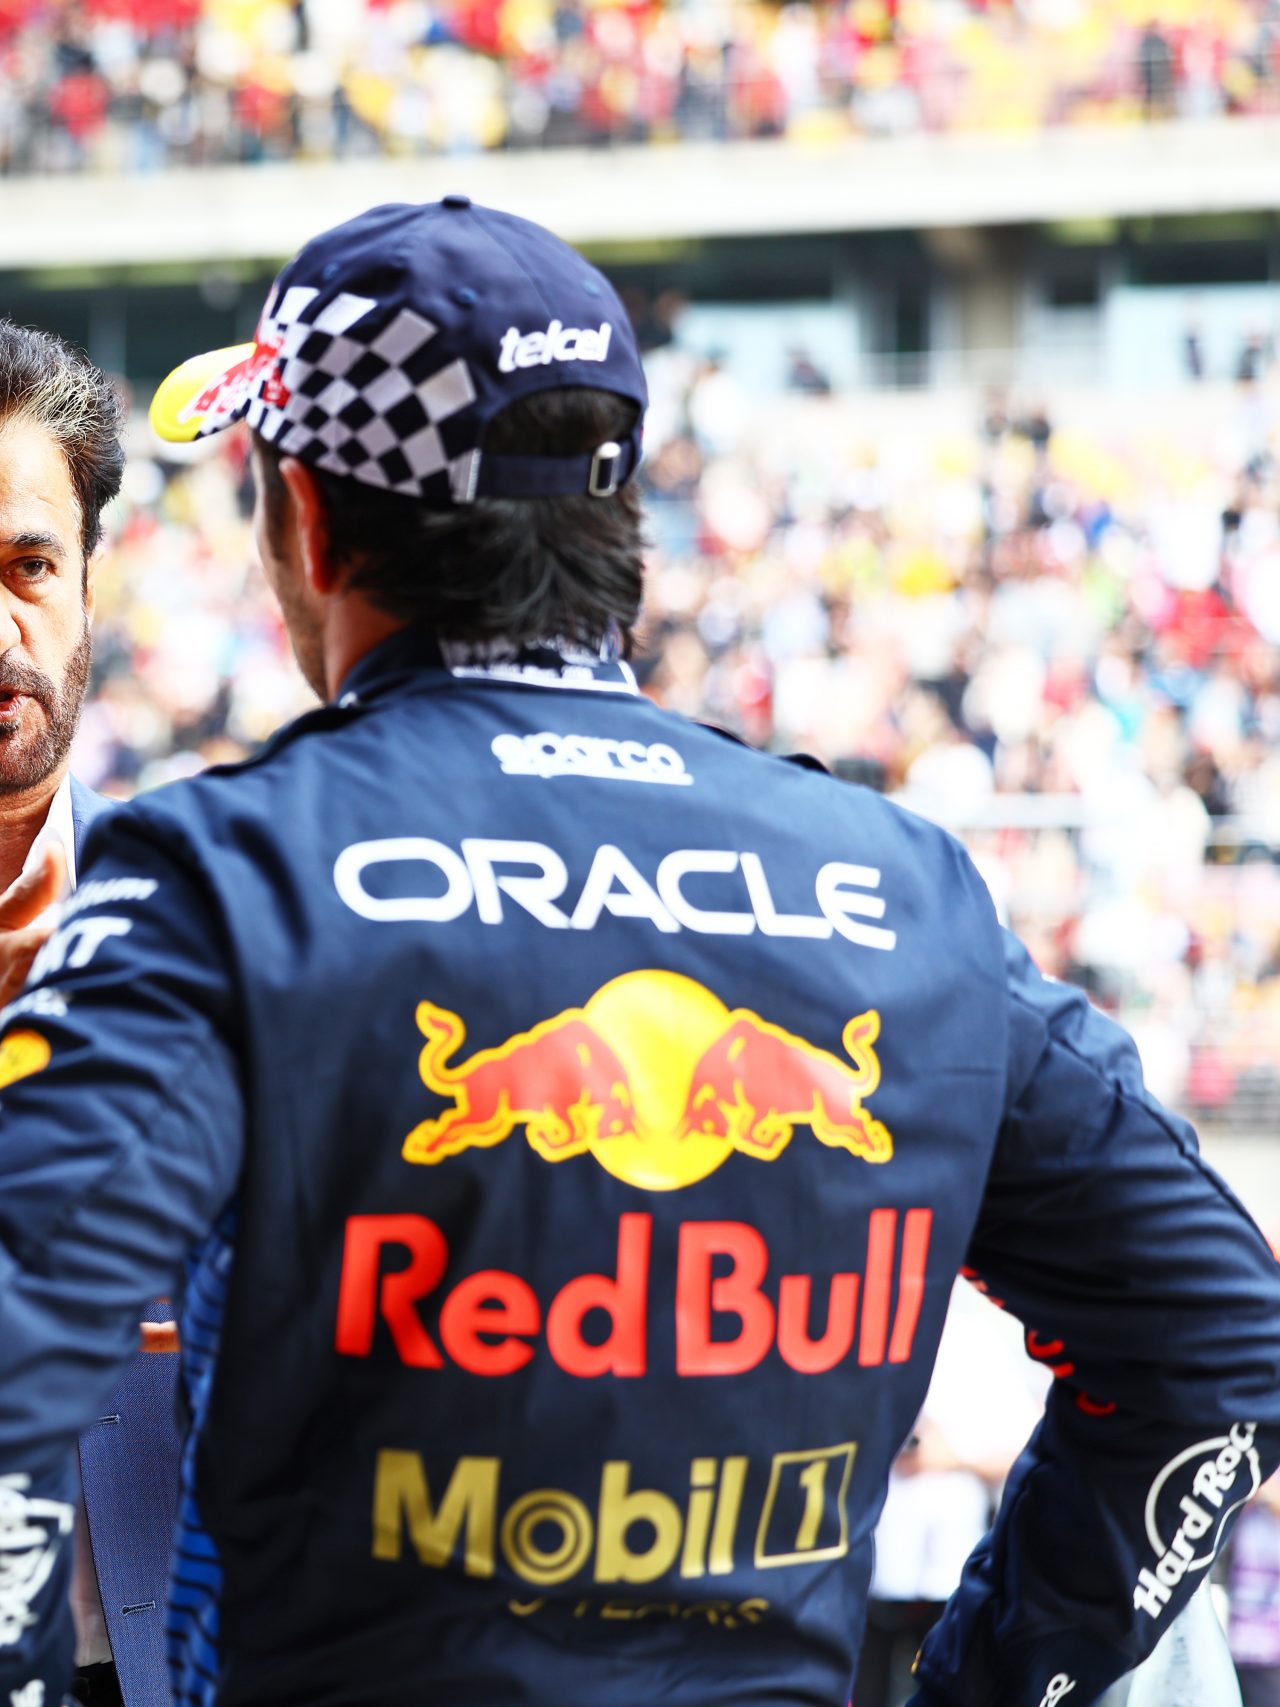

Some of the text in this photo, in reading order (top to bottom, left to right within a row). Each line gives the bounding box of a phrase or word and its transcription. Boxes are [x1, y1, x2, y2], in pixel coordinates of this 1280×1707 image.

[498, 319, 612, 373] telcel
[333, 836, 897, 951] ORACLE
[335, 1213, 653, 1379] Red
[675, 1208, 934, 1378] Bull
[372, 1448, 828, 1586] Mobil 1
[1133, 1495, 1214, 1620] Hard
[1193, 1421, 1258, 1508] Roc
